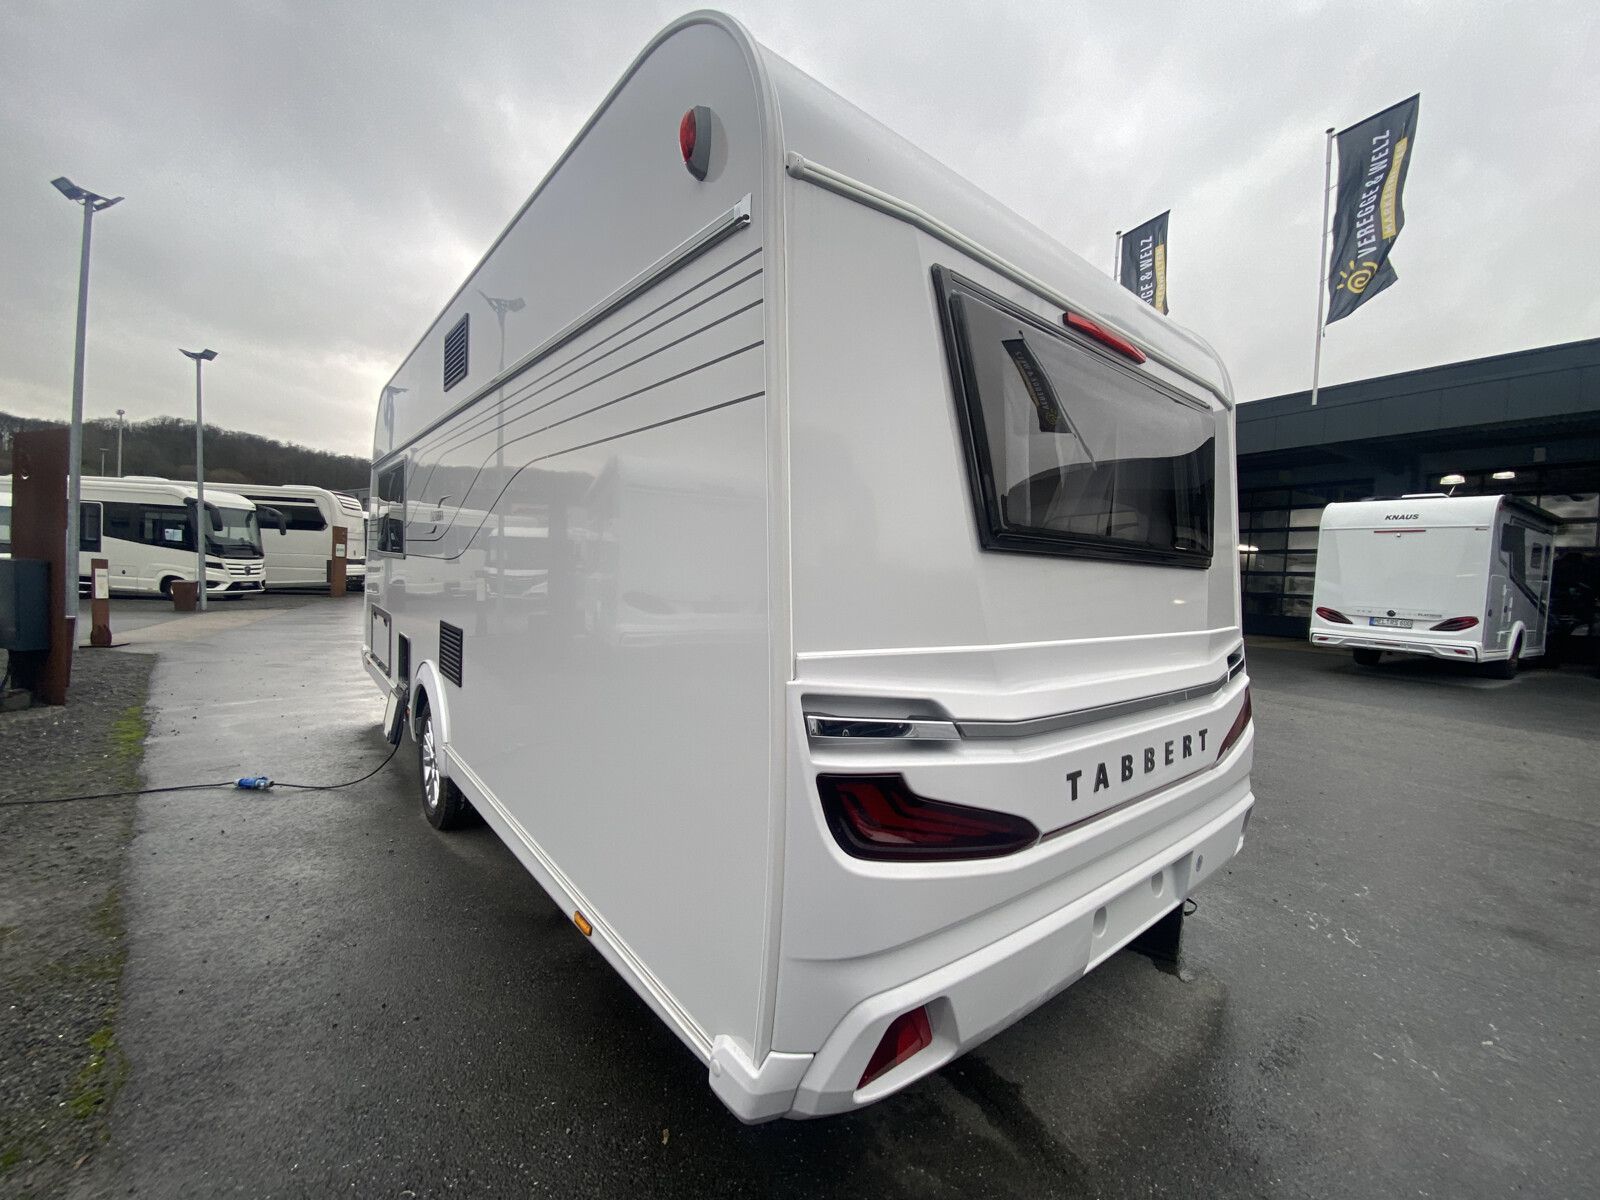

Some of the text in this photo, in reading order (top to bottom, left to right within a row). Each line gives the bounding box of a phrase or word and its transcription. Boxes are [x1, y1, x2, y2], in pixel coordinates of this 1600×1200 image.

[1355, 129, 1390, 259] VEREGGE & WELZ
[1140, 235, 1153, 271] WELZ
[1140, 270, 1153, 281] &
[1384, 513, 1420, 521] KNAUS
[1065, 728, 1208, 801] TABBERT
